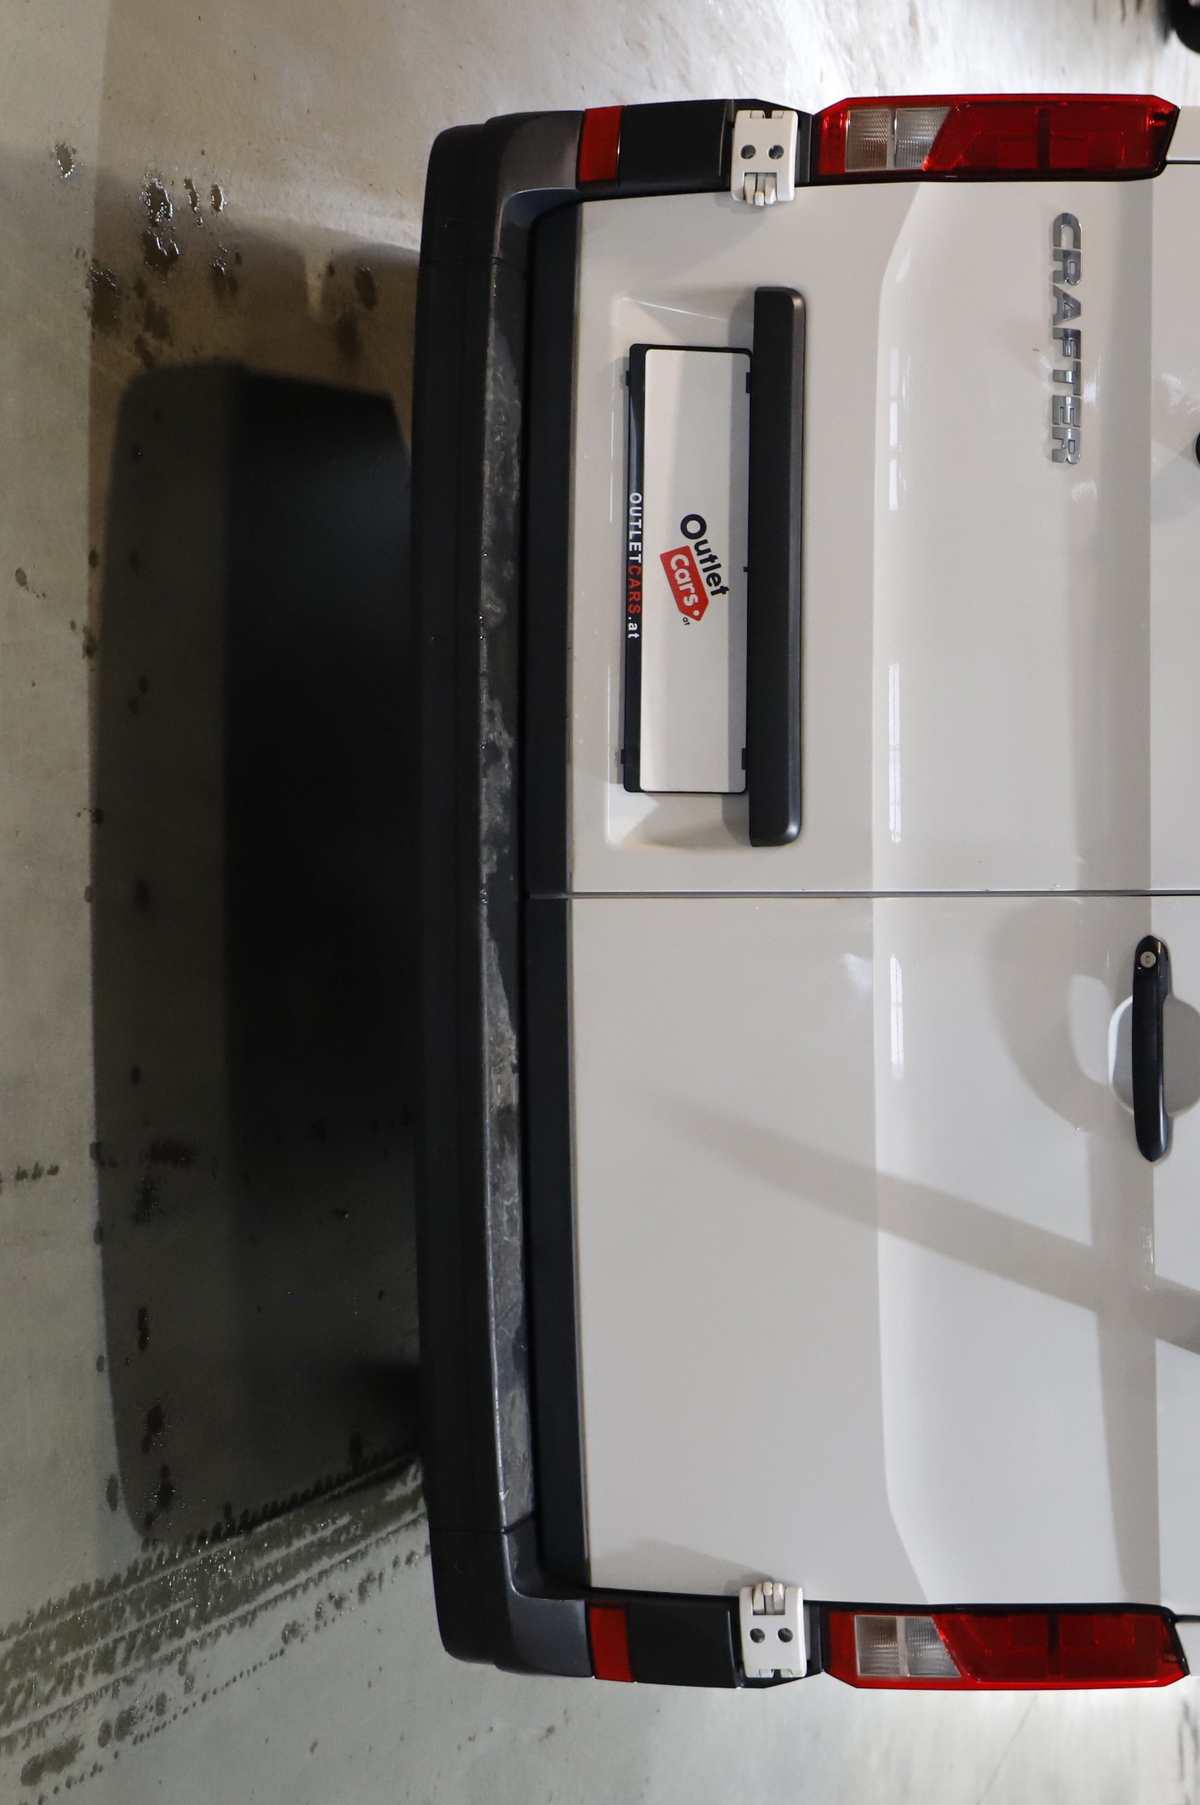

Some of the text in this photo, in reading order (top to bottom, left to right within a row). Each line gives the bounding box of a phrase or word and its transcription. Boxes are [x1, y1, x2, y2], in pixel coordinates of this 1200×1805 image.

[1052, 212, 1082, 464] CRAFTER
[627, 492, 642, 638] OUTLETCARS.at
[670, 554, 698, 607] Cars
[680, 514, 729, 596] Outlet
